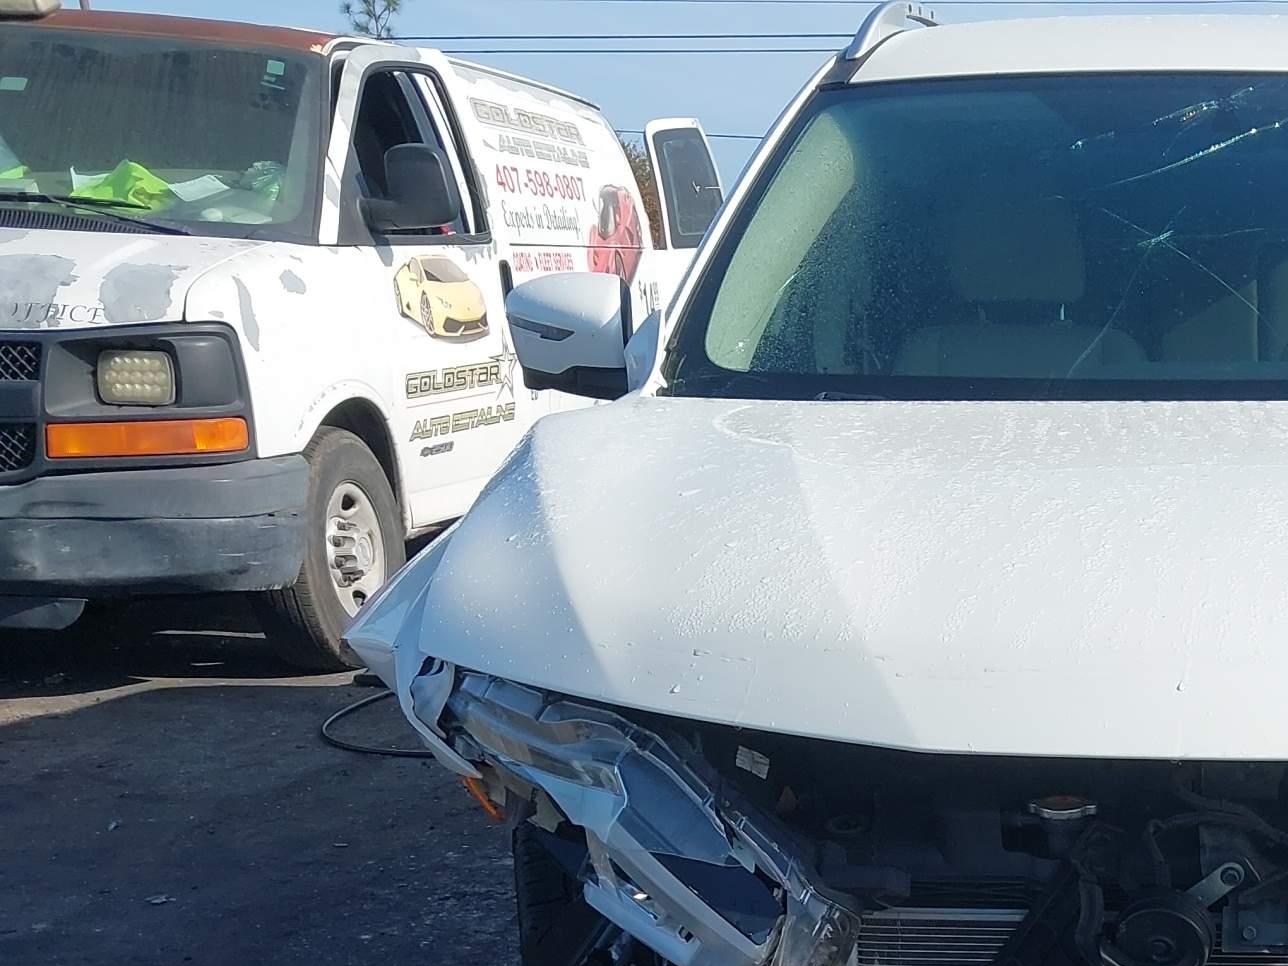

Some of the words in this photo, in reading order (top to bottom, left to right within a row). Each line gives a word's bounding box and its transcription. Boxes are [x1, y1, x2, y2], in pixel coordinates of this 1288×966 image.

[470, 97, 586, 146] GOLDSTAR
[498, 134, 536, 158] AUTO
[496, 164, 587, 202] 407-598-0807
[502, 199, 535, 237] Experts
[535, 207, 545, 231] in
[405, 360, 503, 399] GOLDSTAR
[409, 415, 451, 442] AUTO
